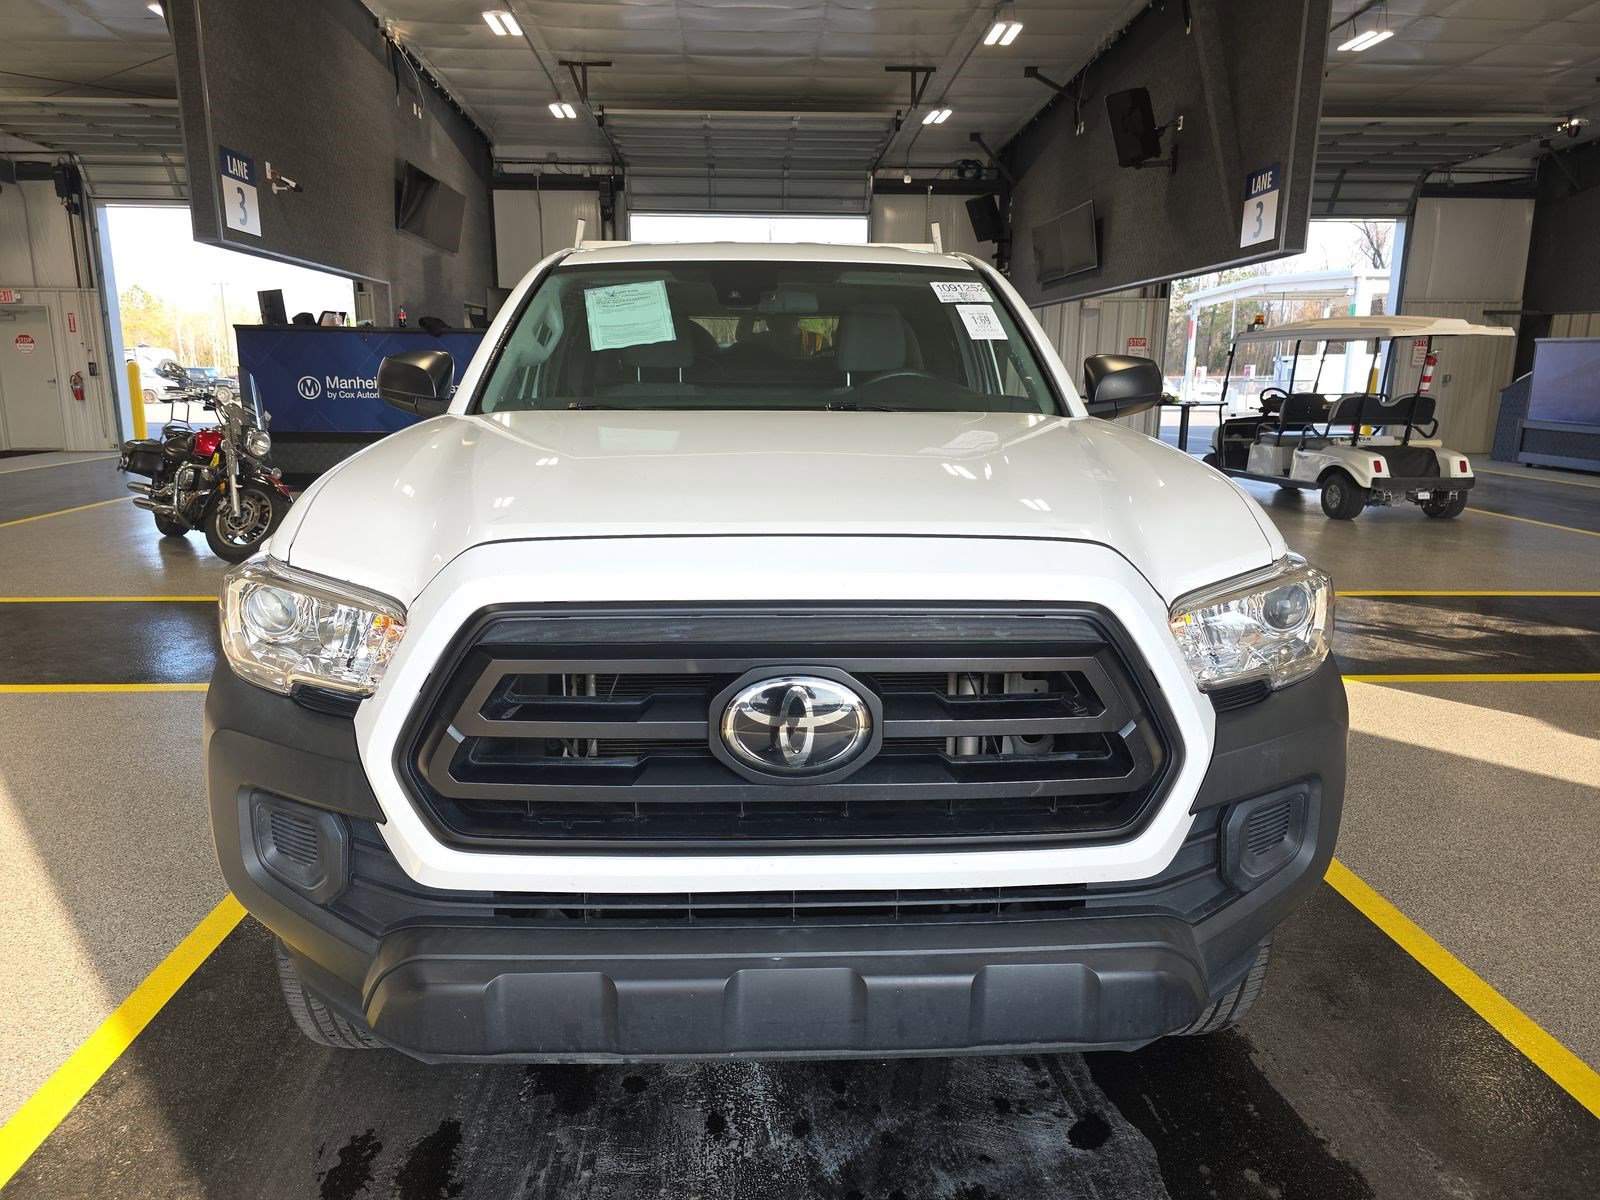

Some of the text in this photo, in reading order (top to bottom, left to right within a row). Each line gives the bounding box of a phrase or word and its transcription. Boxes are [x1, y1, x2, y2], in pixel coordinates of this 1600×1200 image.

[226, 154, 249, 180] LANE
[1251, 170, 1273, 195] LANE
[236, 186, 248, 226] 3
[1252, 200, 1264, 238] 3
[325, 375, 378, 390] Manhei
[327, 391, 338, 400] by
[339, 390, 355, 399] Cox
